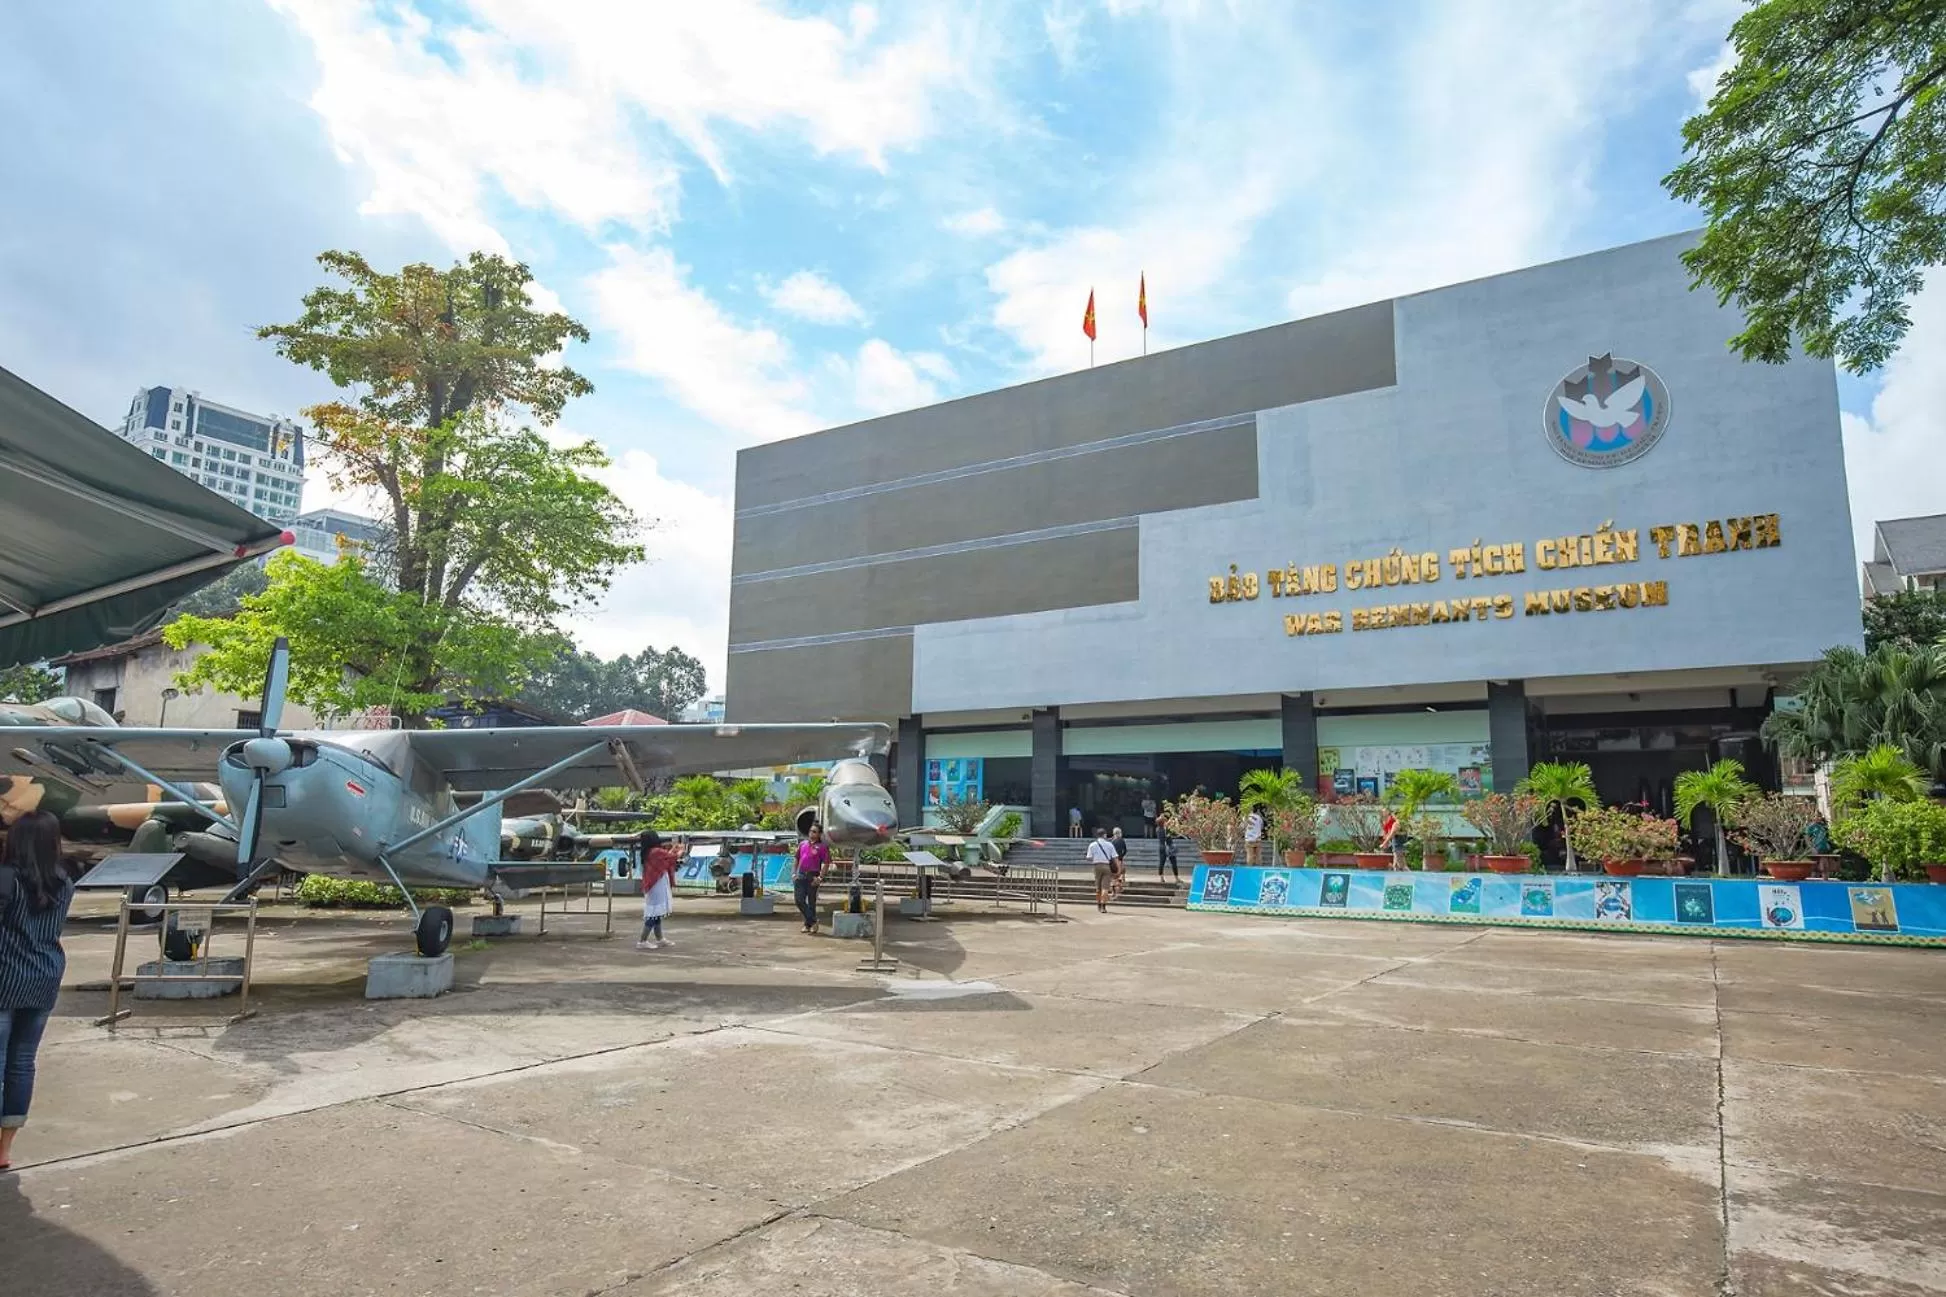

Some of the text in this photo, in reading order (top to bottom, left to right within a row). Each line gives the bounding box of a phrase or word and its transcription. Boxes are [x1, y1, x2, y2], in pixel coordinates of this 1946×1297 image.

[1209, 564, 1260, 603] BẢO
[1268, 560, 1337, 598] TÀNG
[1448, 538, 1526, 580] TÍCH
[1536, 519, 1640, 570] CHIẾN
[1650, 513, 1782, 559] TRANH
[1284, 580, 1668, 637] WAR REMNANTS MUSEUM
